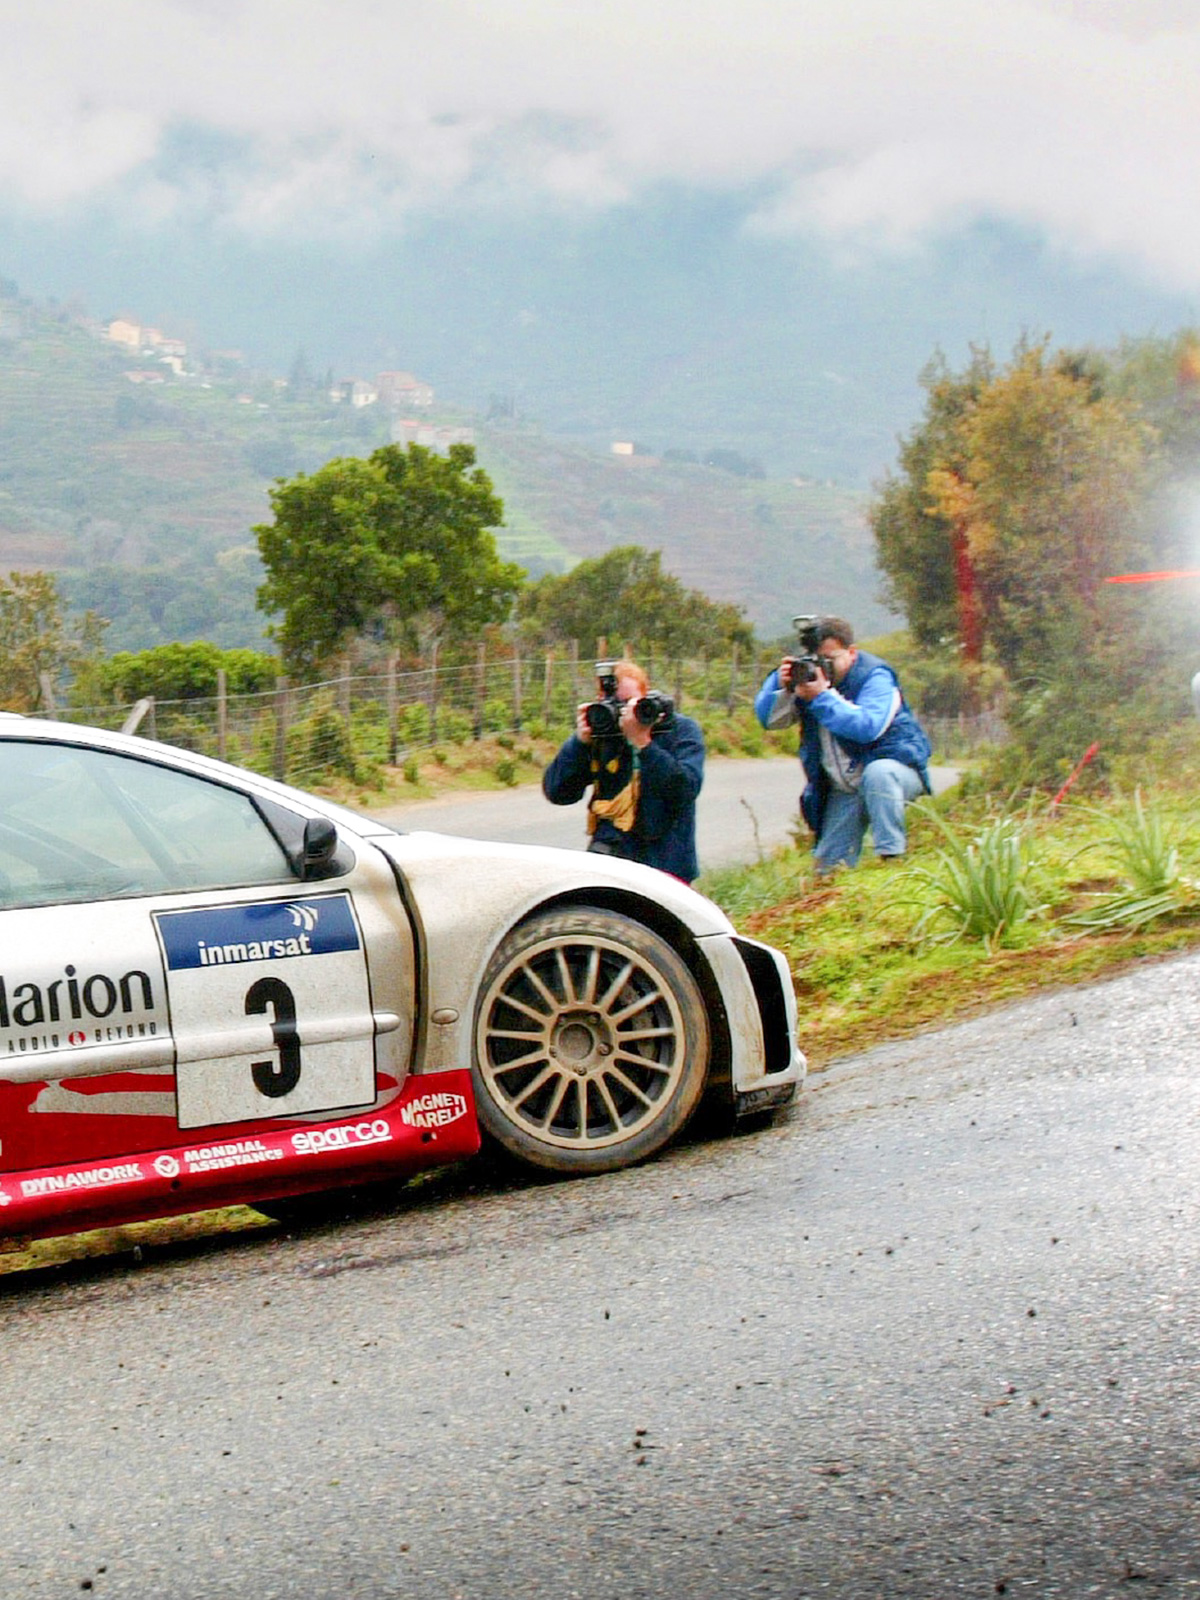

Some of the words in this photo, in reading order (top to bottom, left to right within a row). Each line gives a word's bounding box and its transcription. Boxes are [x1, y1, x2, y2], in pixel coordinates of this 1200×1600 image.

[198, 933, 312, 965] inmarsat
[8, 1034, 60, 1054] AUDIO
[95, 1021, 158, 1043] BEYOND
[245, 977, 301, 1098] 3
[184, 1140, 266, 1163] MONDIAL
[291, 1119, 393, 1156] sparco
[189, 1148, 284, 1174] ASSISTANCE
[21, 1163, 144, 1195] DYNAWORK
